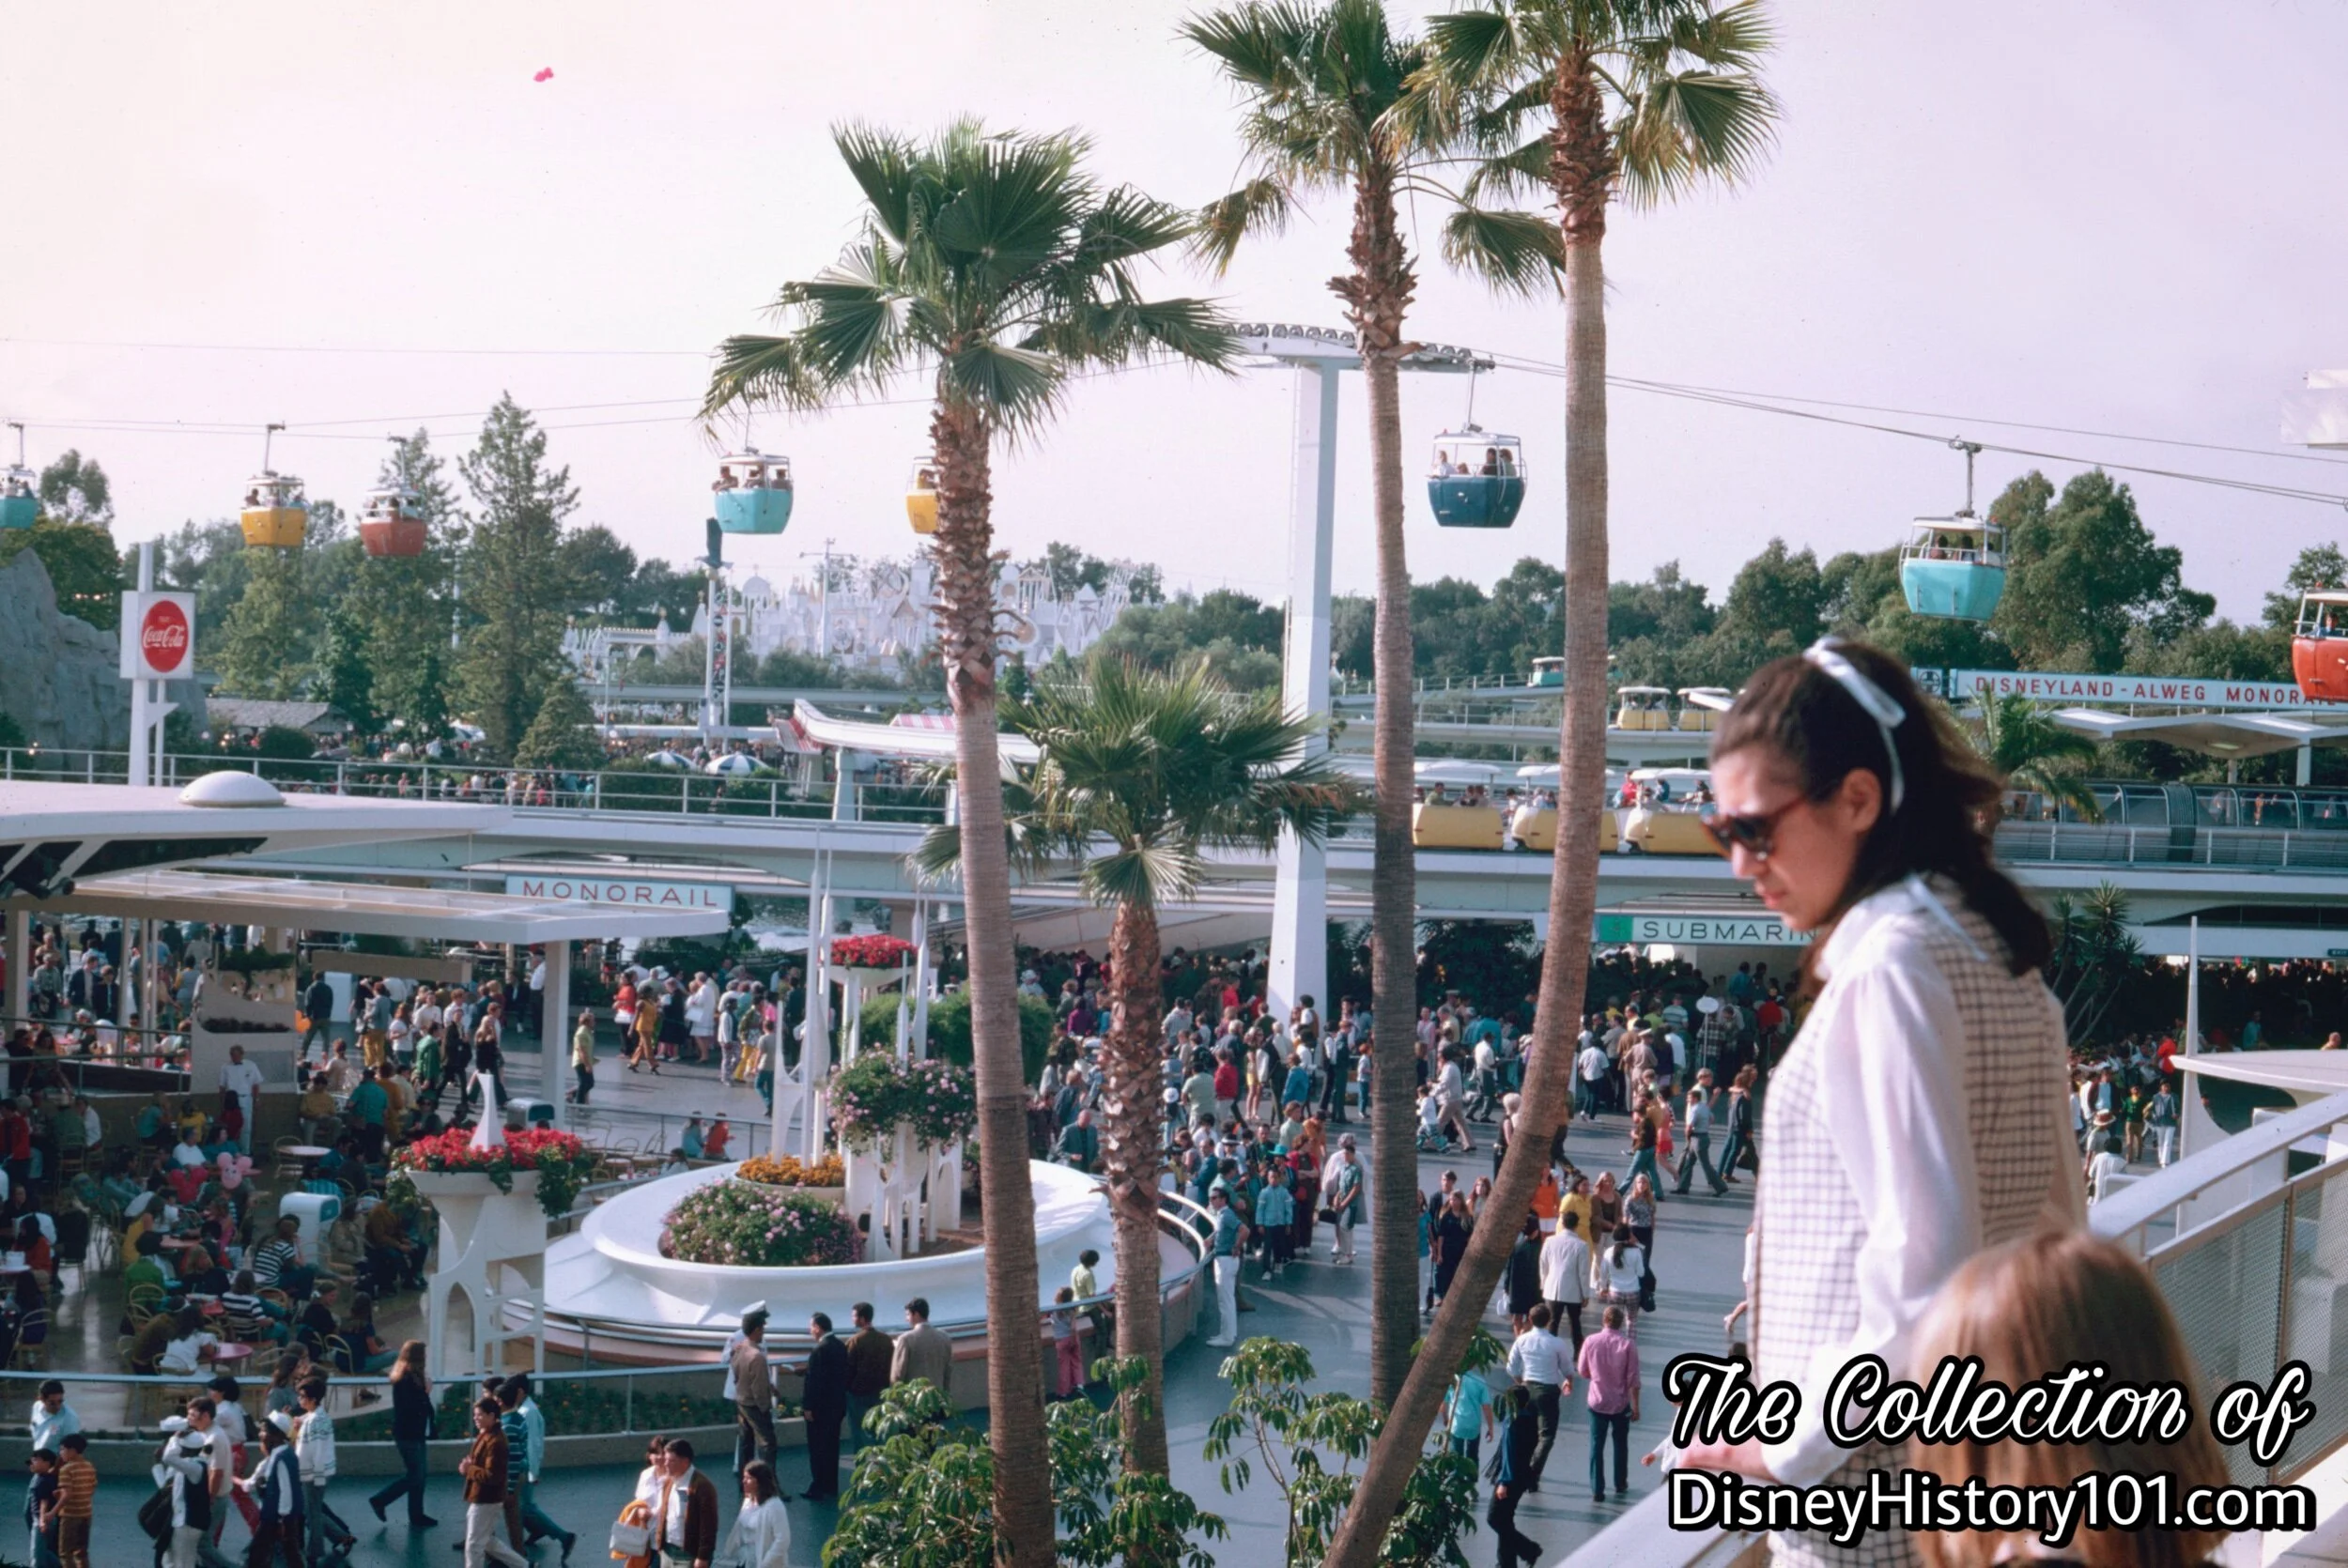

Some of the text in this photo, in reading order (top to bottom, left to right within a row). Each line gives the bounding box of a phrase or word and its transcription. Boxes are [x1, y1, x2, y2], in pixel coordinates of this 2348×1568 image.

[1975, 676, 2113, 697] DISNEYLAND
[2134, 683, 2205, 699] ALWEG
[2226, 686, 2337, 706] MONOR
[523, 880, 718, 907] MONORAIL
[1643, 920, 1818, 943] SUBMARIN
